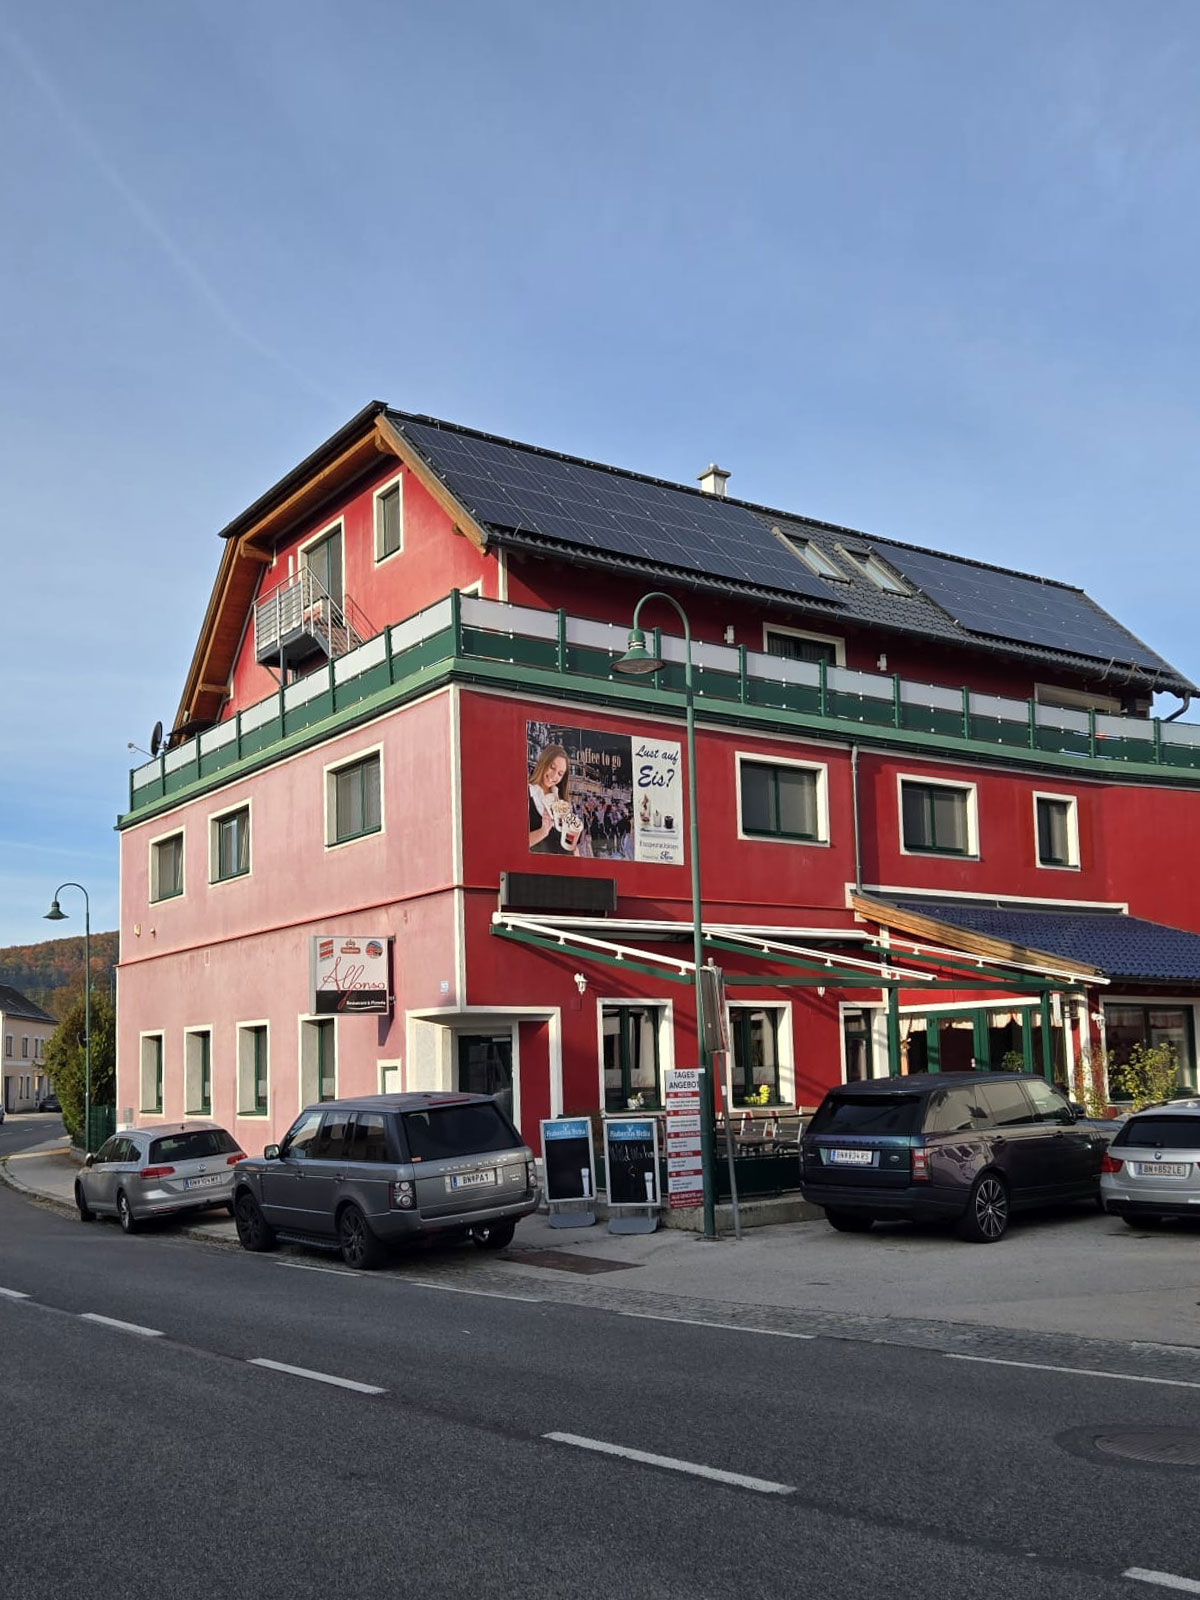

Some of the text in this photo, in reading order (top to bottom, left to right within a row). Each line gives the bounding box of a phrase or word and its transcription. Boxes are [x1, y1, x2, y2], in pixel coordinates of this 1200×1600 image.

[576, 747, 622, 771] coffee to go
[635, 744, 679, 766] Lust auf
[637, 764, 675, 788] Eis?
[318, 956, 386, 1011] Alfonso
[673, 1071, 696, 1079] TAGES
